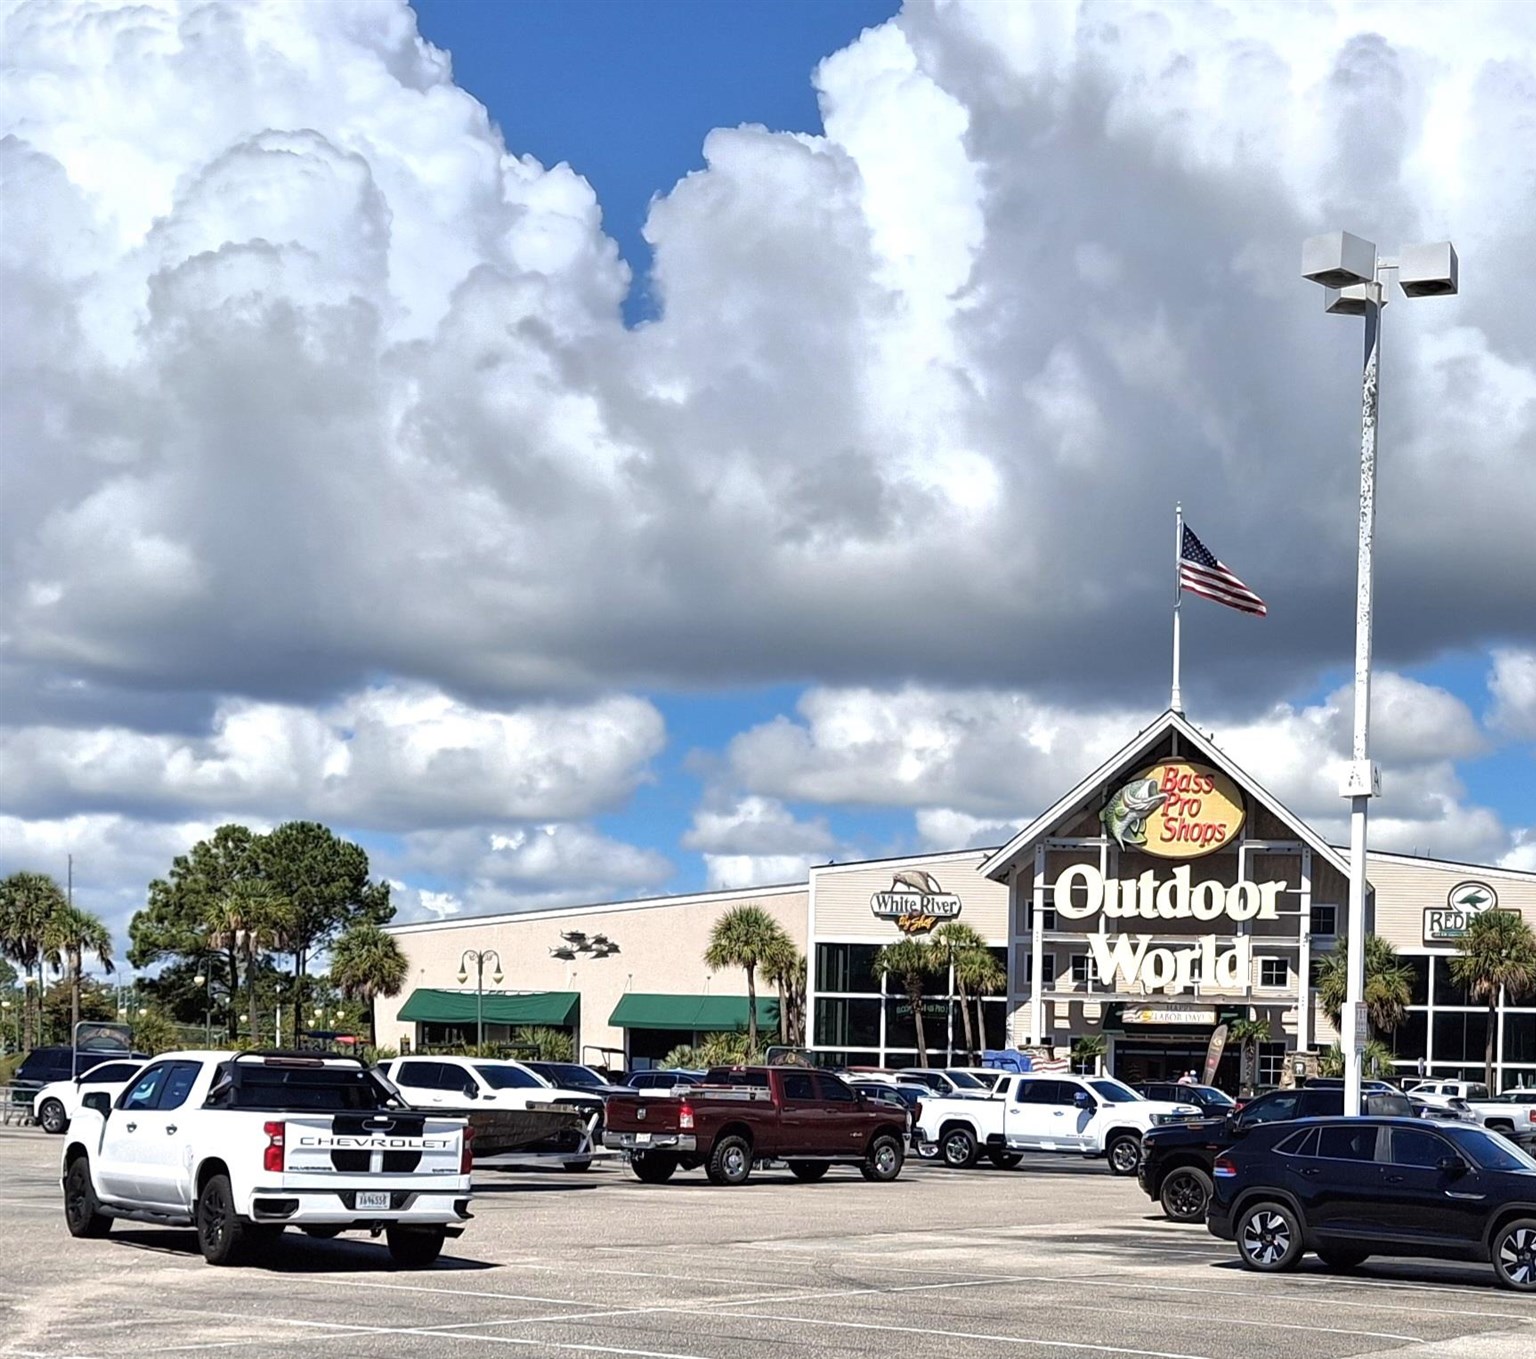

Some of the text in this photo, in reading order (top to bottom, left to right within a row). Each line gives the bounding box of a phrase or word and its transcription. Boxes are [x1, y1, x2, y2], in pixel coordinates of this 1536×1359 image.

[1159, 766, 1215, 794] Bass
[1160, 792, 1202, 817] Pro
[1160, 817, 1227, 848] Shops
[876, 895, 957, 914] White River
[1054, 863, 1288, 921] Outdoor
[1087, 933, 1250, 988] World
[300, 1137, 451, 1148] CHEVROLET
